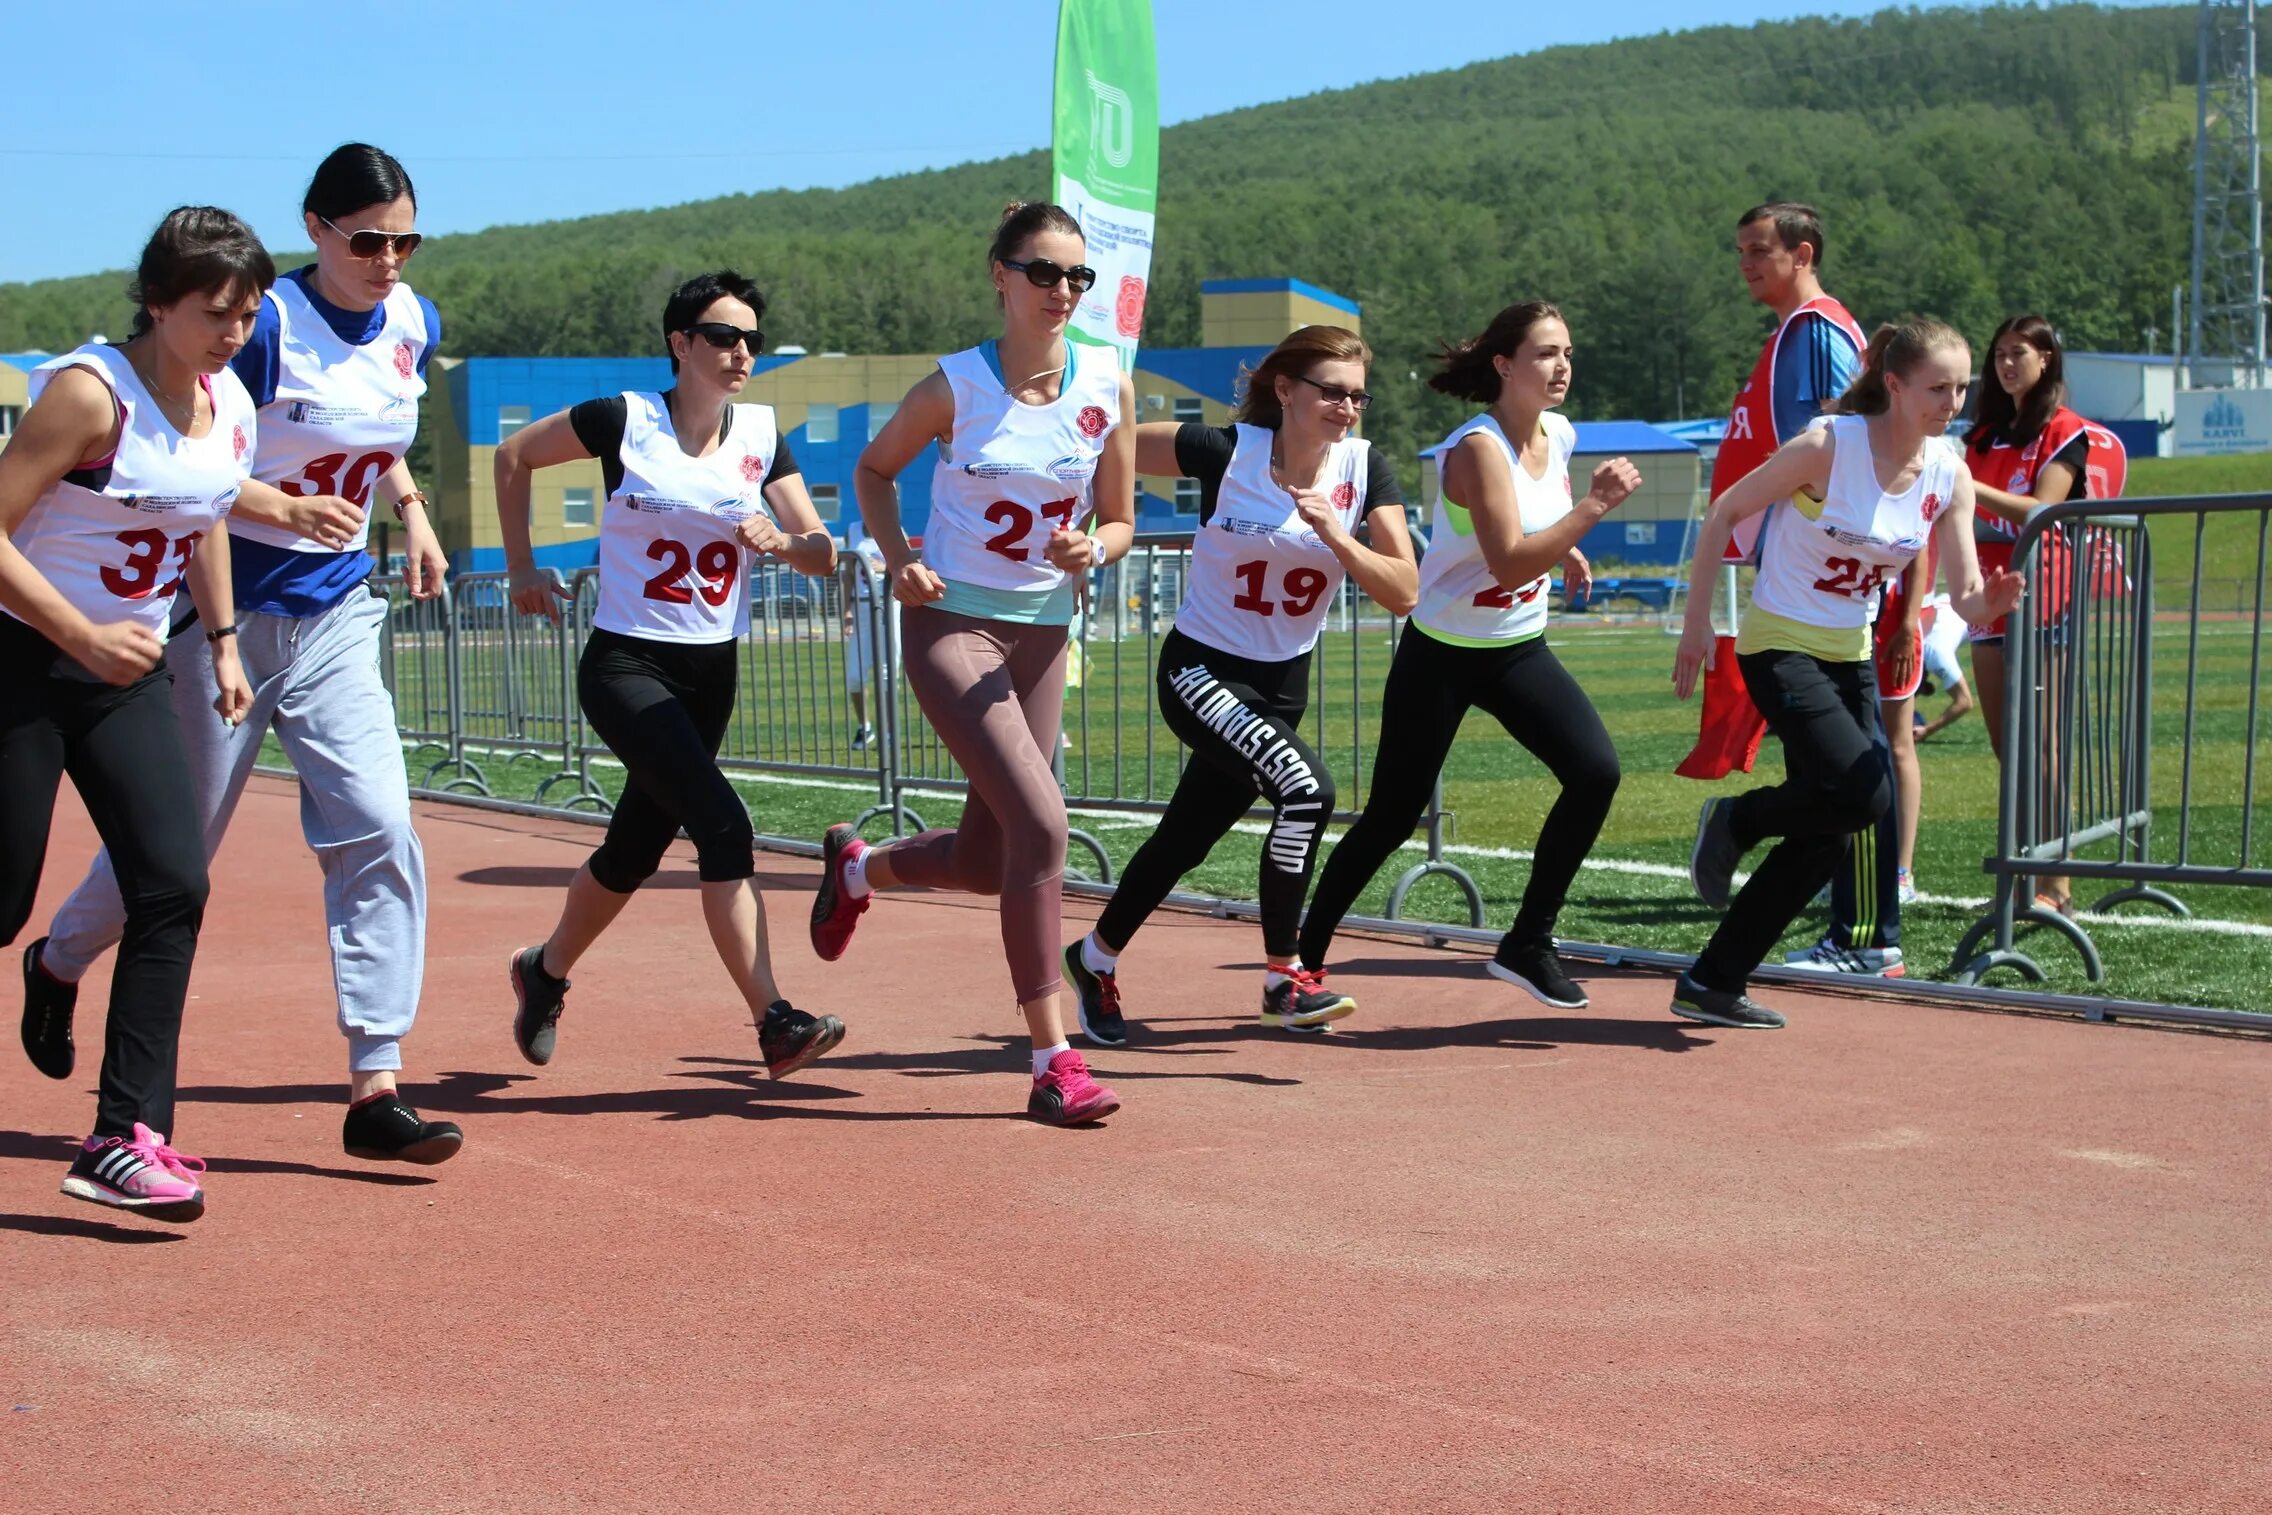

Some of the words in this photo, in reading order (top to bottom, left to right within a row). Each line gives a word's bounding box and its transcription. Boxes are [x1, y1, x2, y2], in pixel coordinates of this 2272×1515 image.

[280, 451, 395, 509] 30
[984, 496, 1078, 562] 27
[643, 538, 738, 606] 29
[1234, 559, 1328, 617] 19
[1196, 687, 1277, 761] STAND
[1253, 738, 1320, 797] JUST
[1269, 802, 1322, 874] DON'T
